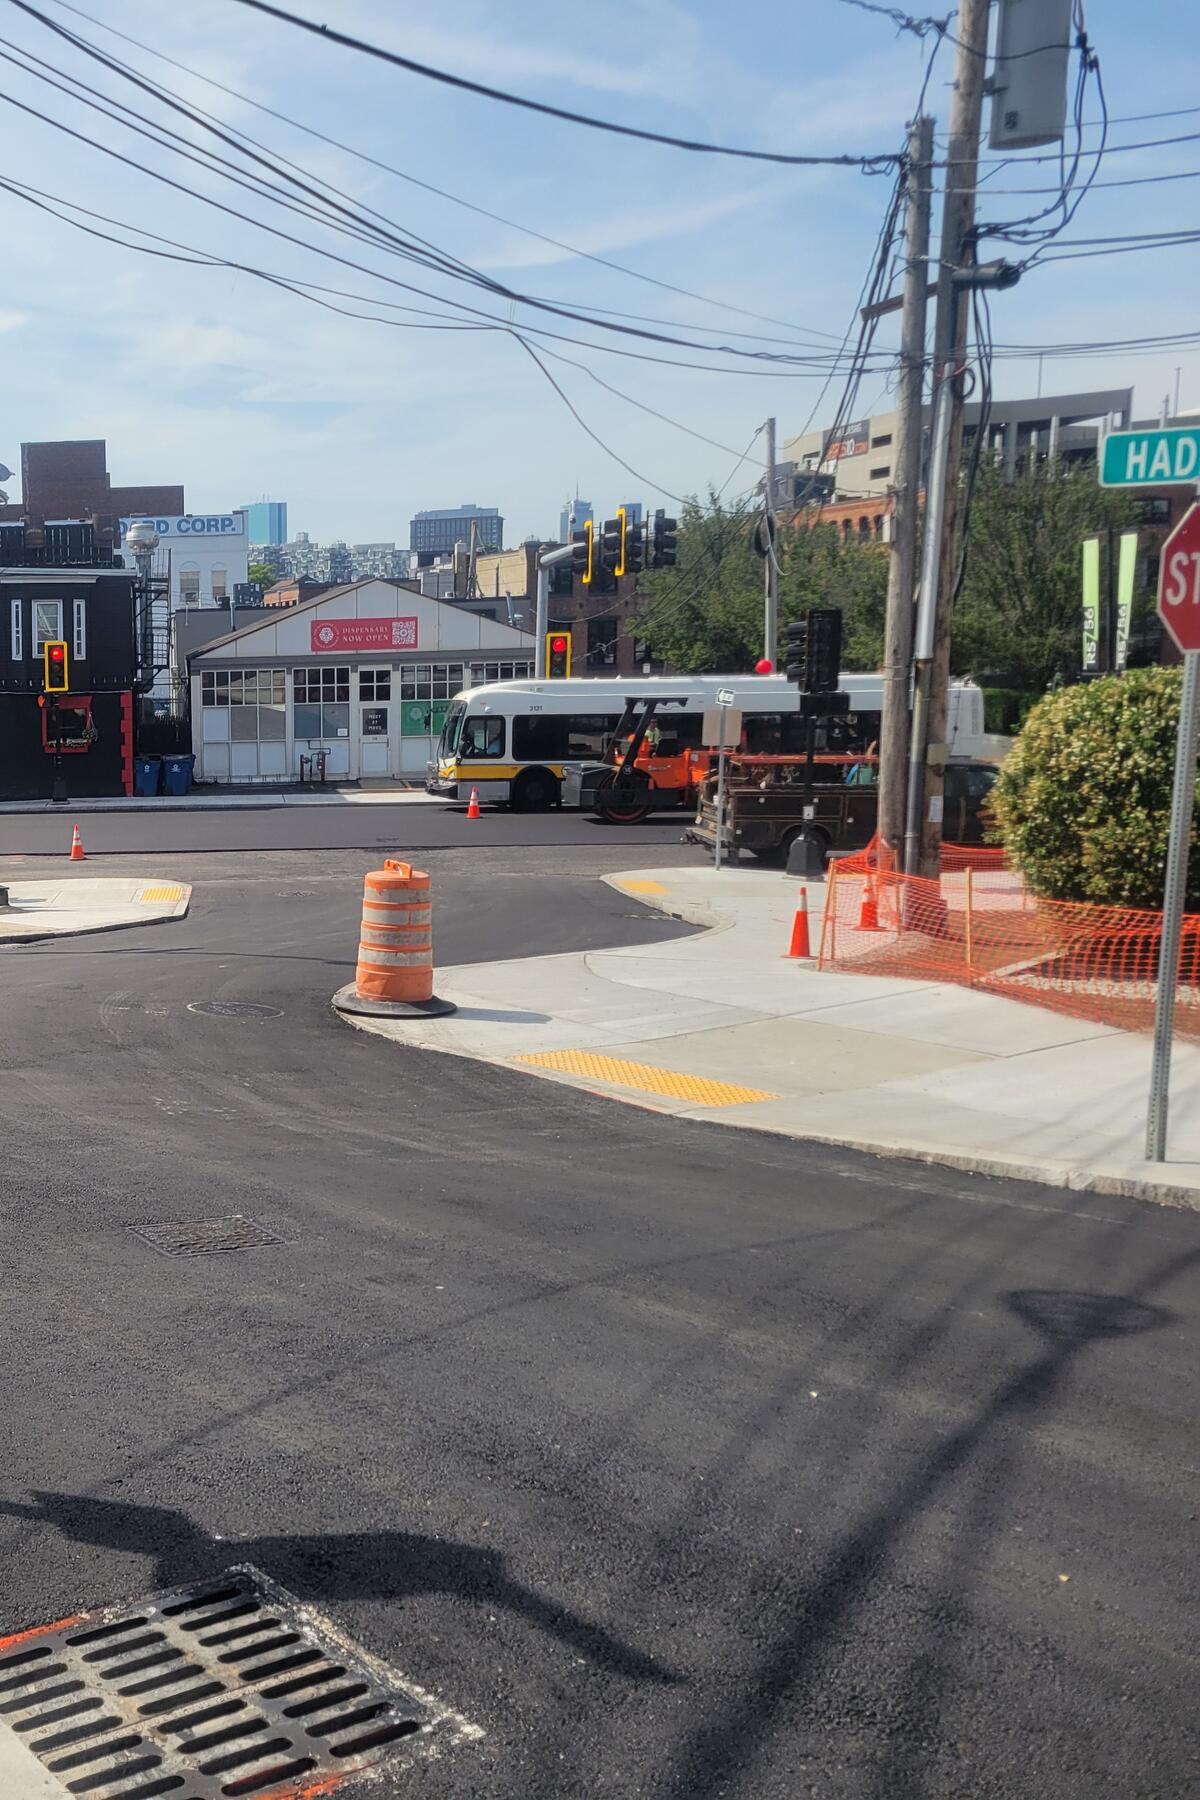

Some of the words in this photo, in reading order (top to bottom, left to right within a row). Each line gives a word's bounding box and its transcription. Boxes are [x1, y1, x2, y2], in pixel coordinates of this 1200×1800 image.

[176, 517, 236, 534] CORP.
[342, 626, 388, 634] DISPENSARY
[343, 635, 362, 643] NOW
[366, 633, 389, 642] OPEN
